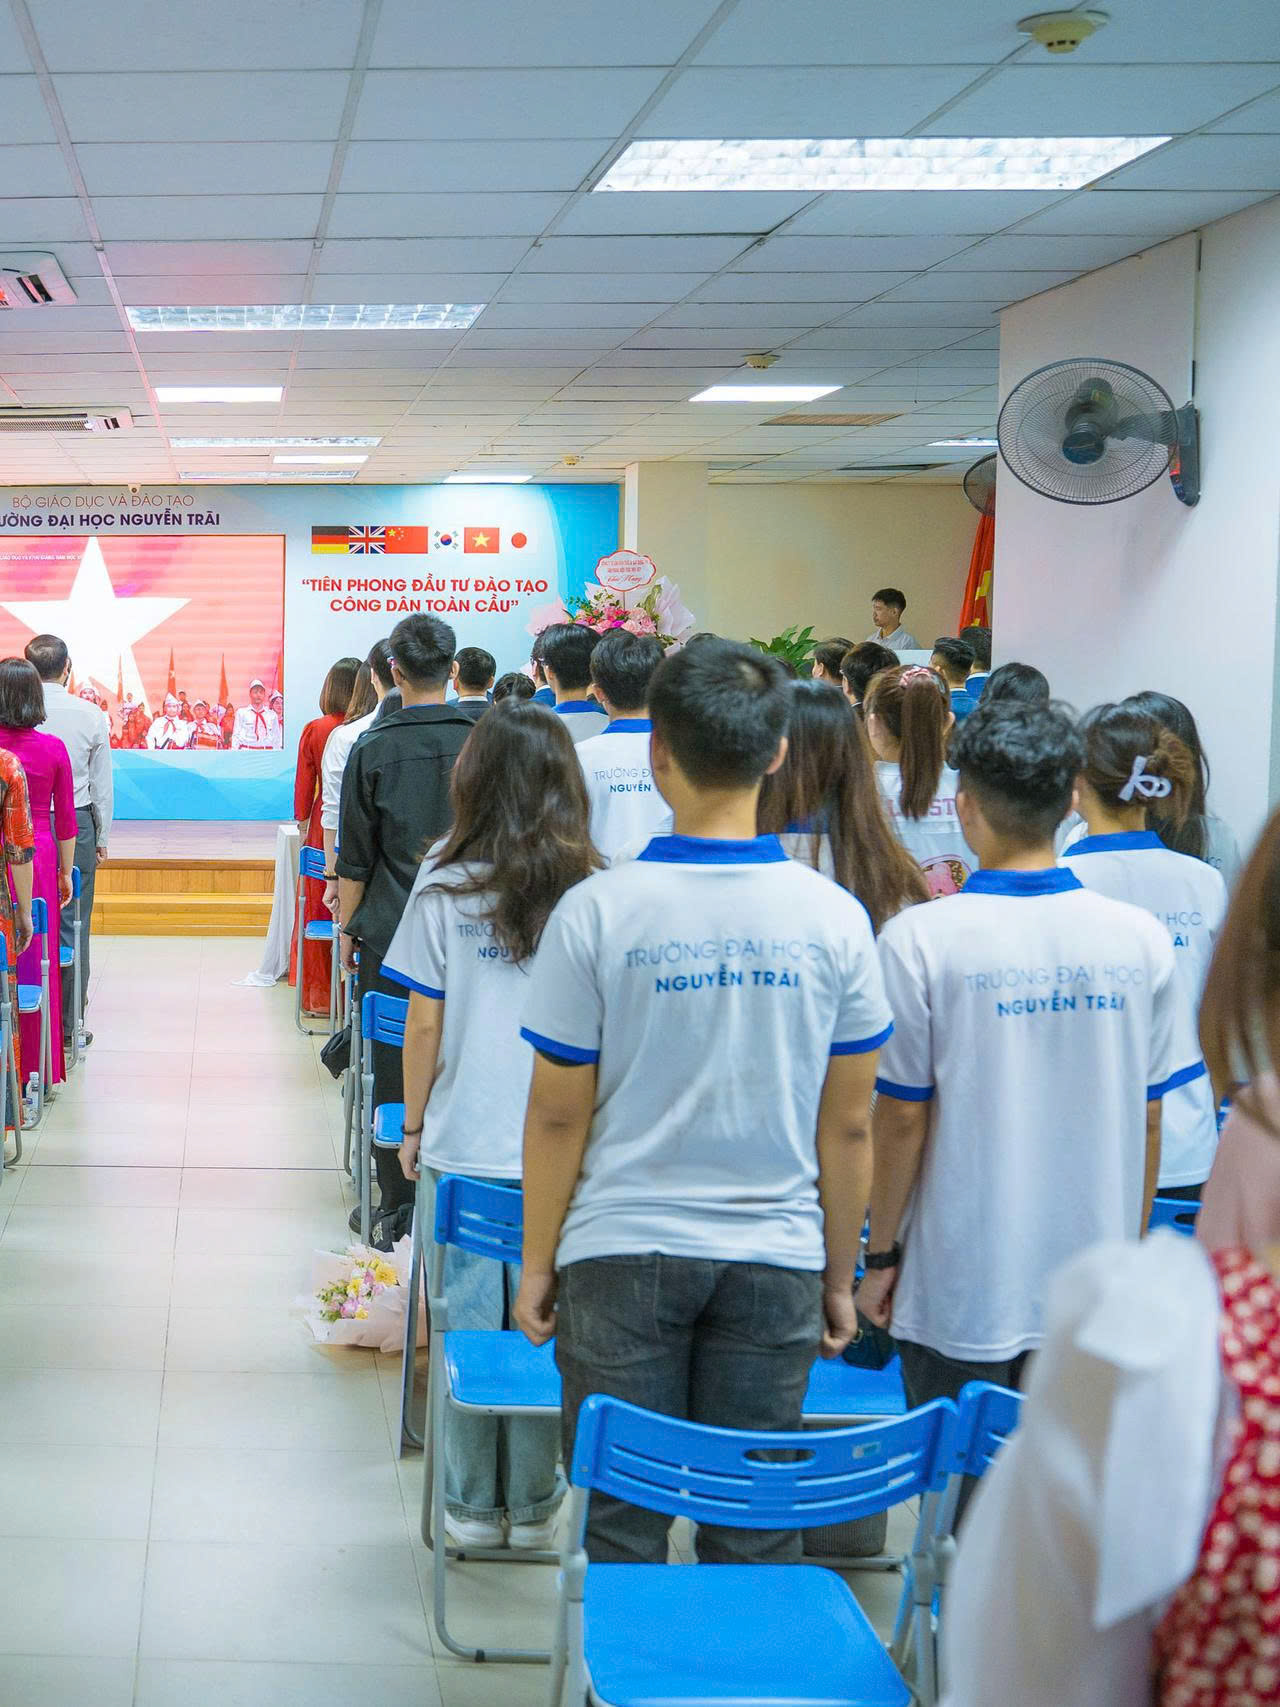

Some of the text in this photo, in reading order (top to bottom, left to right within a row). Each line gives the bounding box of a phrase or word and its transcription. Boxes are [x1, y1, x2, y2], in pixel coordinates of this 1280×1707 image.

[12, 492, 195, 510] BỘ GIÁO DỤC VÀ ĐÀO TẠO
[47, 514, 75, 530] ĐẠI
[79, 513, 115, 530] HỌC
[119, 508, 183, 527] NGUYỄN
[186, 510, 221, 526] TRÃI
[347, 578, 407, 592] PHONG
[411, 573, 446, 592] ĐẦU
[450, 577, 470, 592] TƯ
[474, 576, 511, 592] ĐÀO
[515, 579, 548, 596] TẠO
[329, 593, 519, 613] CÔNG DÂN TOÀN CẦU”
[593, 766, 638, 781] TRƯỜNG
[610, 780, 652, 793] NGUYỄN
[457, 920, 496, 938] TRƯỜ
[624, 939, 718, 968] TRƯỜNG
[725, 938, 763, 960] ĐẠI
[655, 963, 799, 993] NGUYỄN TRÃI
[997, 989, 1127, 1017] NGUYỄN TRÃI
